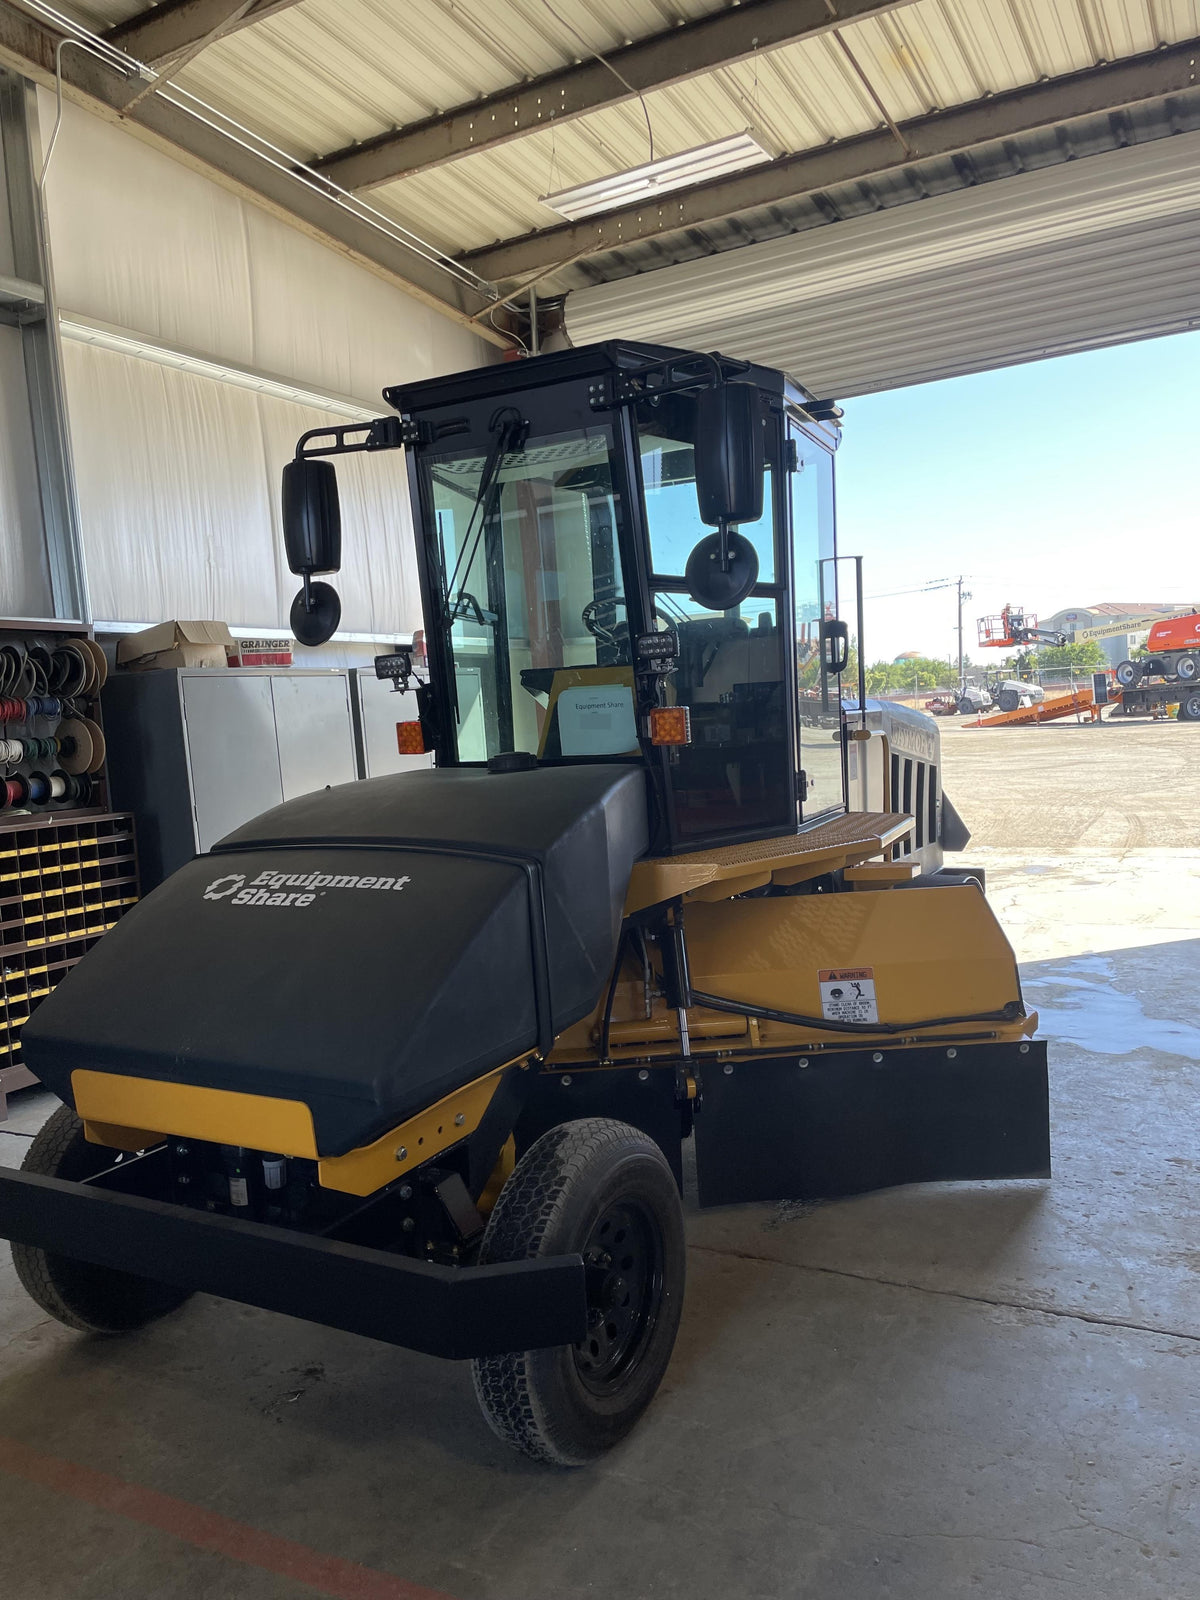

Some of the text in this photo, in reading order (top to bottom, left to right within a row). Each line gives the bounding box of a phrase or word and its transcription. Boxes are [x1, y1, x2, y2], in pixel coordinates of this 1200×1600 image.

[1089, 622, 1142, 637] EquipmentShare
[250, 871, 411, 890] Equipment
[231, 889, 316, 907] Share
